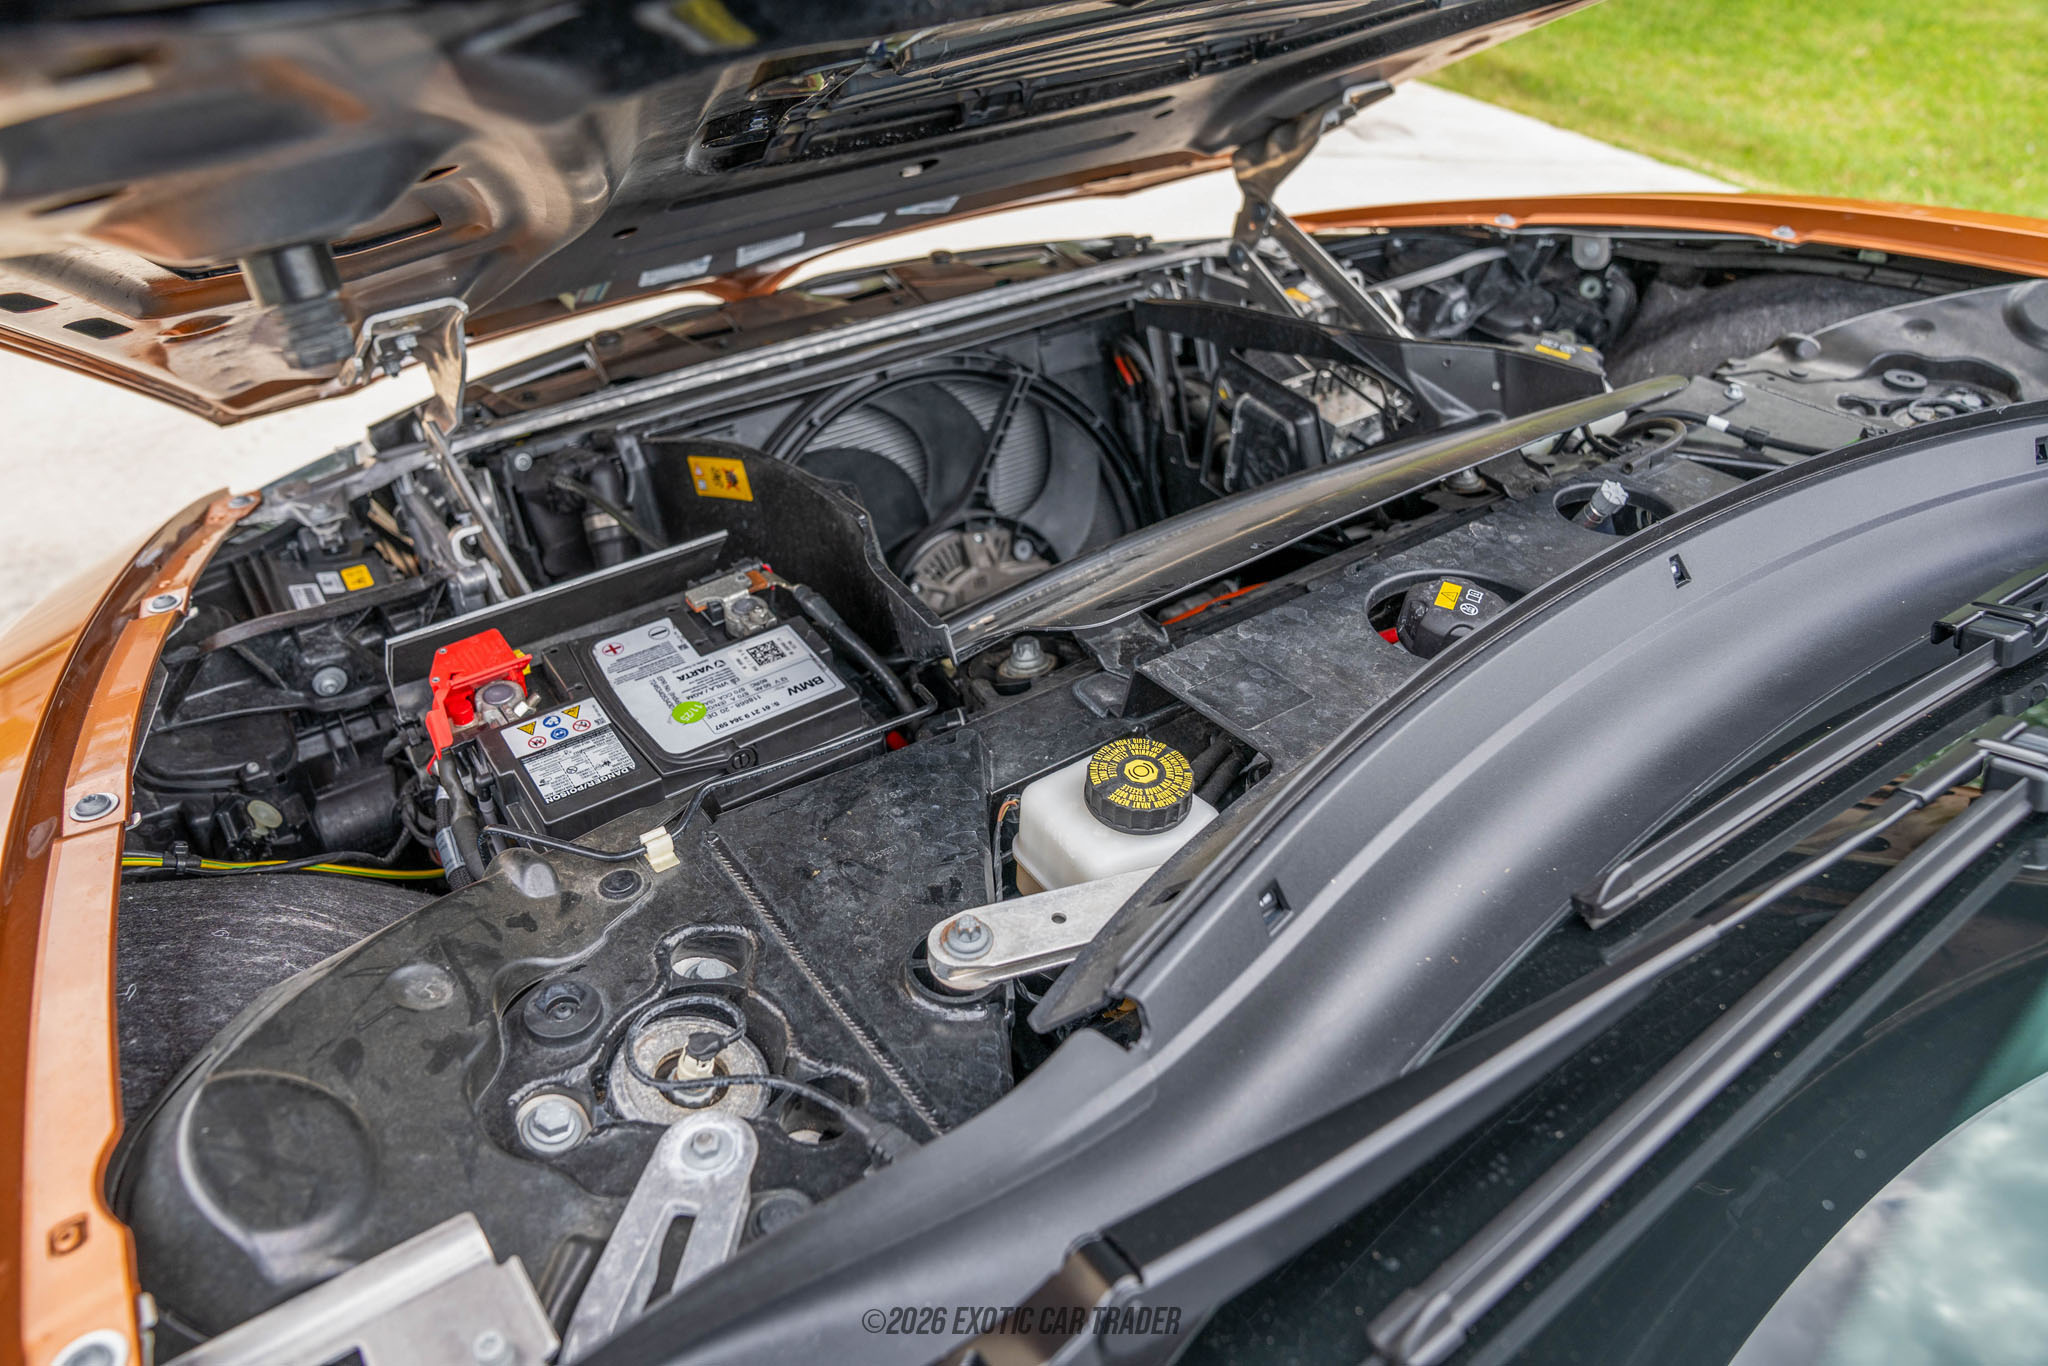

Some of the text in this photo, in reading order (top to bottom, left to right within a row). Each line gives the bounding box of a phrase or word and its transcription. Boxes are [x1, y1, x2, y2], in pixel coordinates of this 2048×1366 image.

[676, 665, 714, 681] VARTA
[787, 676, 825, 696] BMW
[680, 703, 703, 722] 11/25
[715, 722, 729, 730] 597
[1115, 739, 1131, 747] FROM
[1127, 743, 1150, 751] BEFORE
[1151, 746, 1162, 754] CAP
[545, 767, 629, 804] DANGER/POISON
[1121, 784, 1143, 796] SCELLE
[1127, 794, 1146, 803] FREIN
[1132, 801, 1151, 809] AVANT
